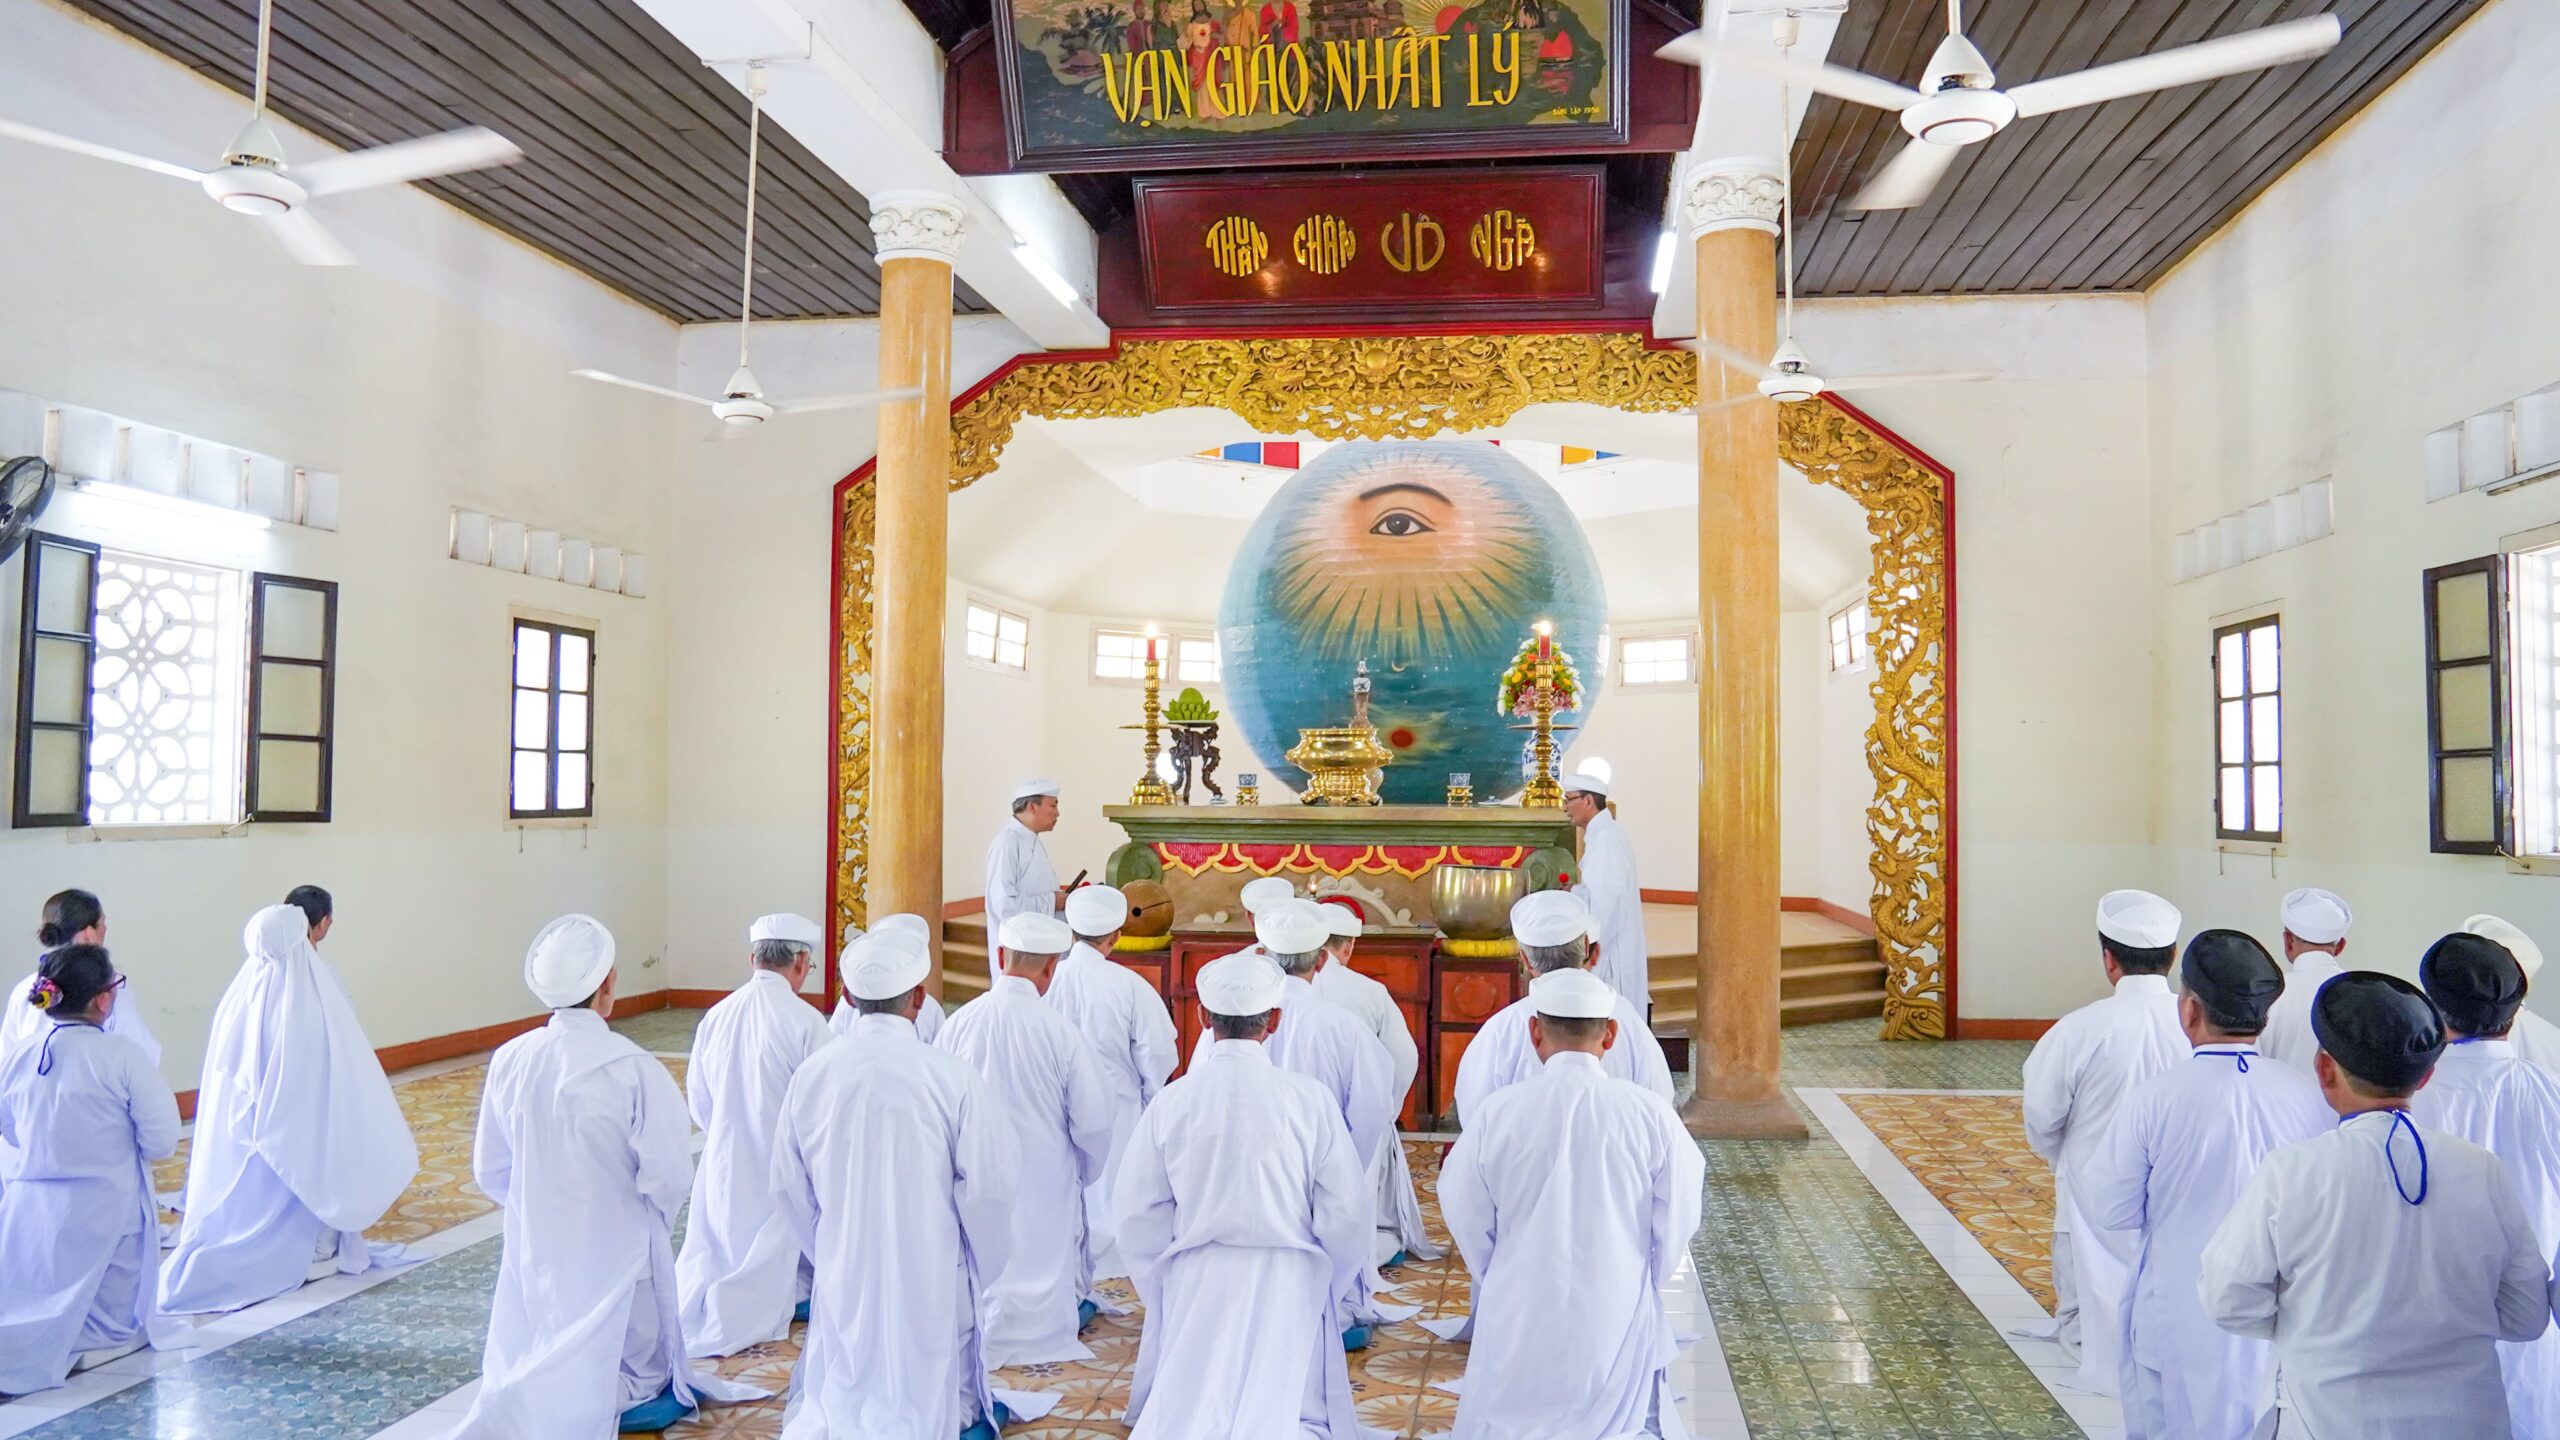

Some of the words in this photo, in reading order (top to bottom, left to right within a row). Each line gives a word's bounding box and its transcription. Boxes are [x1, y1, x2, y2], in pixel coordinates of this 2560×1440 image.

[1100, 48, 1192, 128] VẠN
[1206, 33, 1310, 117] GIÁO
[1324, 26, 1451, 112] NHẤT
[1467, 21, 1521, 106] LÝ
[1293, 214, 1356, 274] CHÂN
[1471, 209, 1535, 271] NGÃ
